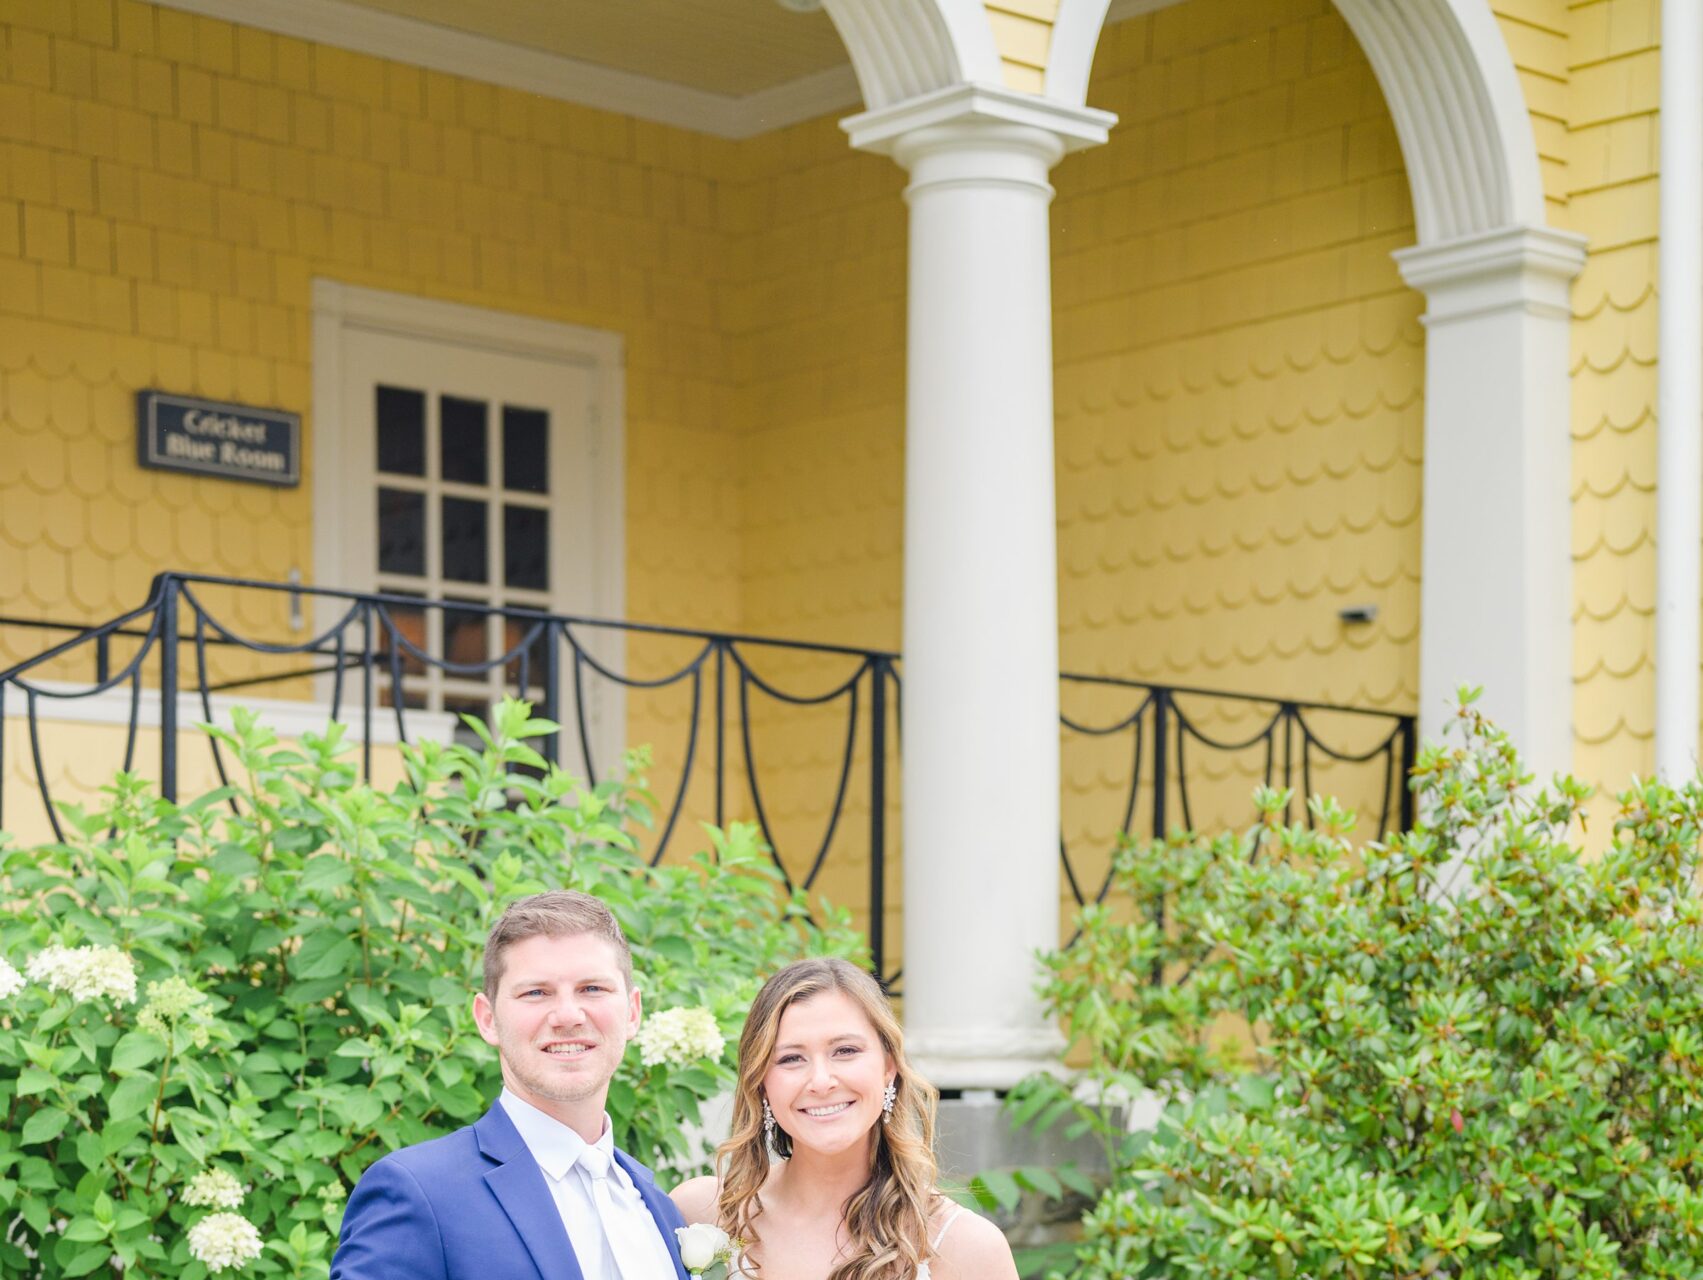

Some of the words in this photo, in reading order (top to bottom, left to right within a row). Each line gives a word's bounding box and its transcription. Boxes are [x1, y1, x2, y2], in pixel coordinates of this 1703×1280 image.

[183, 410, 267, 444] Cricket
[165, 432, 216, 462] Blue
[219, 441, 286, 471] Room
